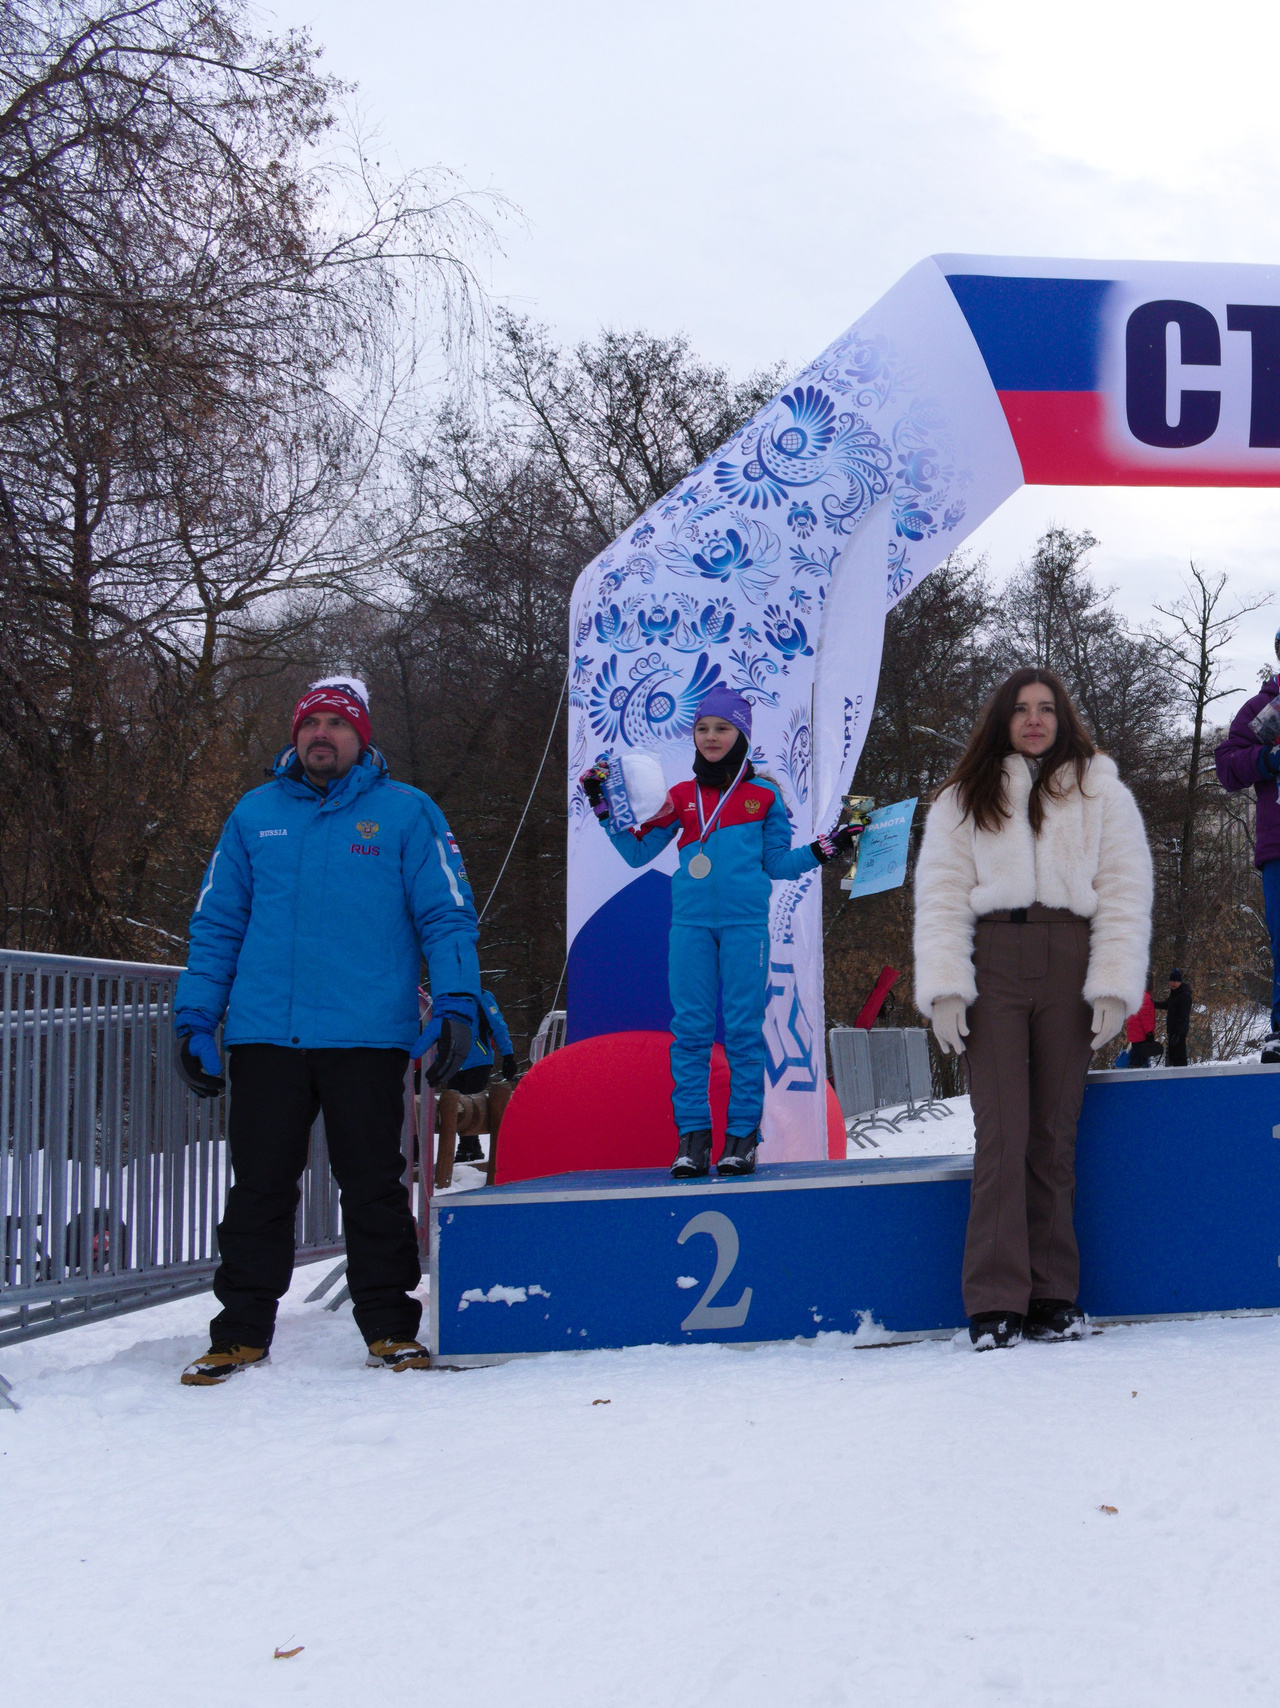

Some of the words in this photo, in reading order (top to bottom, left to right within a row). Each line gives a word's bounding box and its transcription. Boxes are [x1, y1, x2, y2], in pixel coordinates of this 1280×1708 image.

[259, 828, 288, 838] RUSSIA
[350, 844, 380, 856] RUS
[677, 1210, 753, 1331] 2
